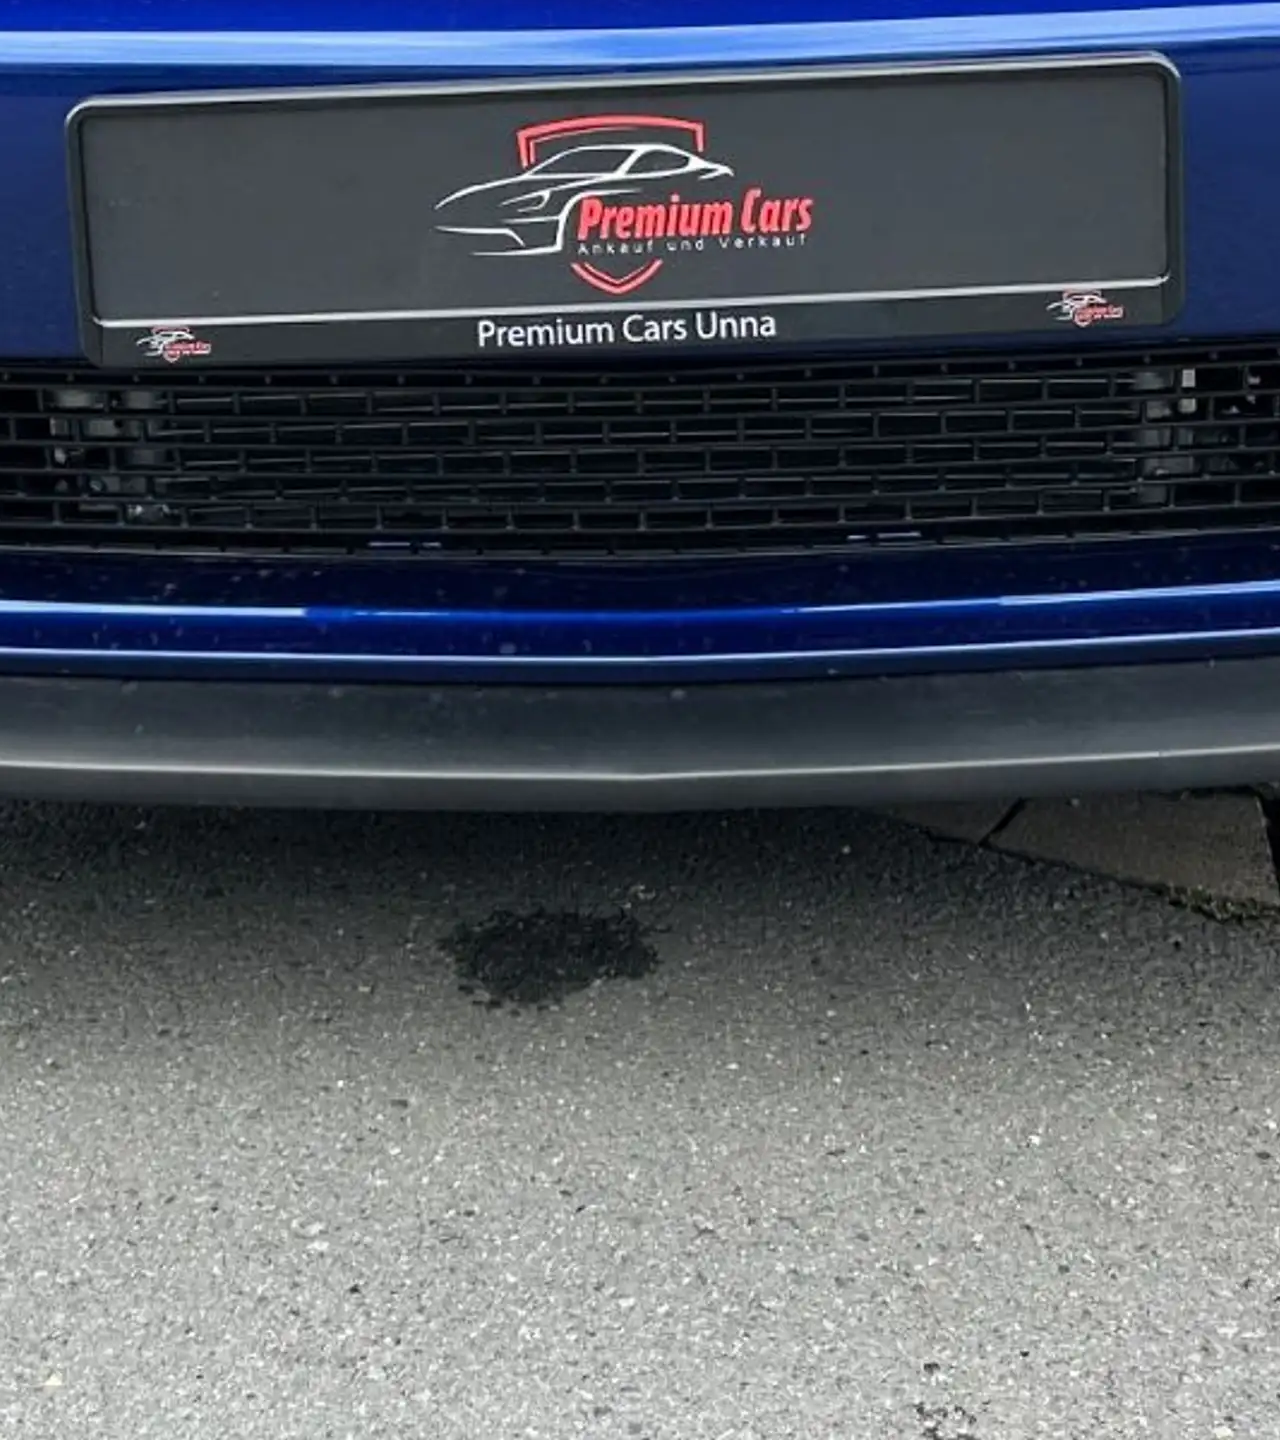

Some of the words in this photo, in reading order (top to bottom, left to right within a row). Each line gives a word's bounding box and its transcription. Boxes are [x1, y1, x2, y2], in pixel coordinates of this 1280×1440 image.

[577, 193, 733, 240] Premium
[741, 187, 813, 234] Cars
[577, 239, 654, 255] Ankauf
[666, 239, 705, 252] und
[477, 318, 615, 347] Premium
[622, 314, 687, 342] Cars
[695, 311, 777, 339] Unna
